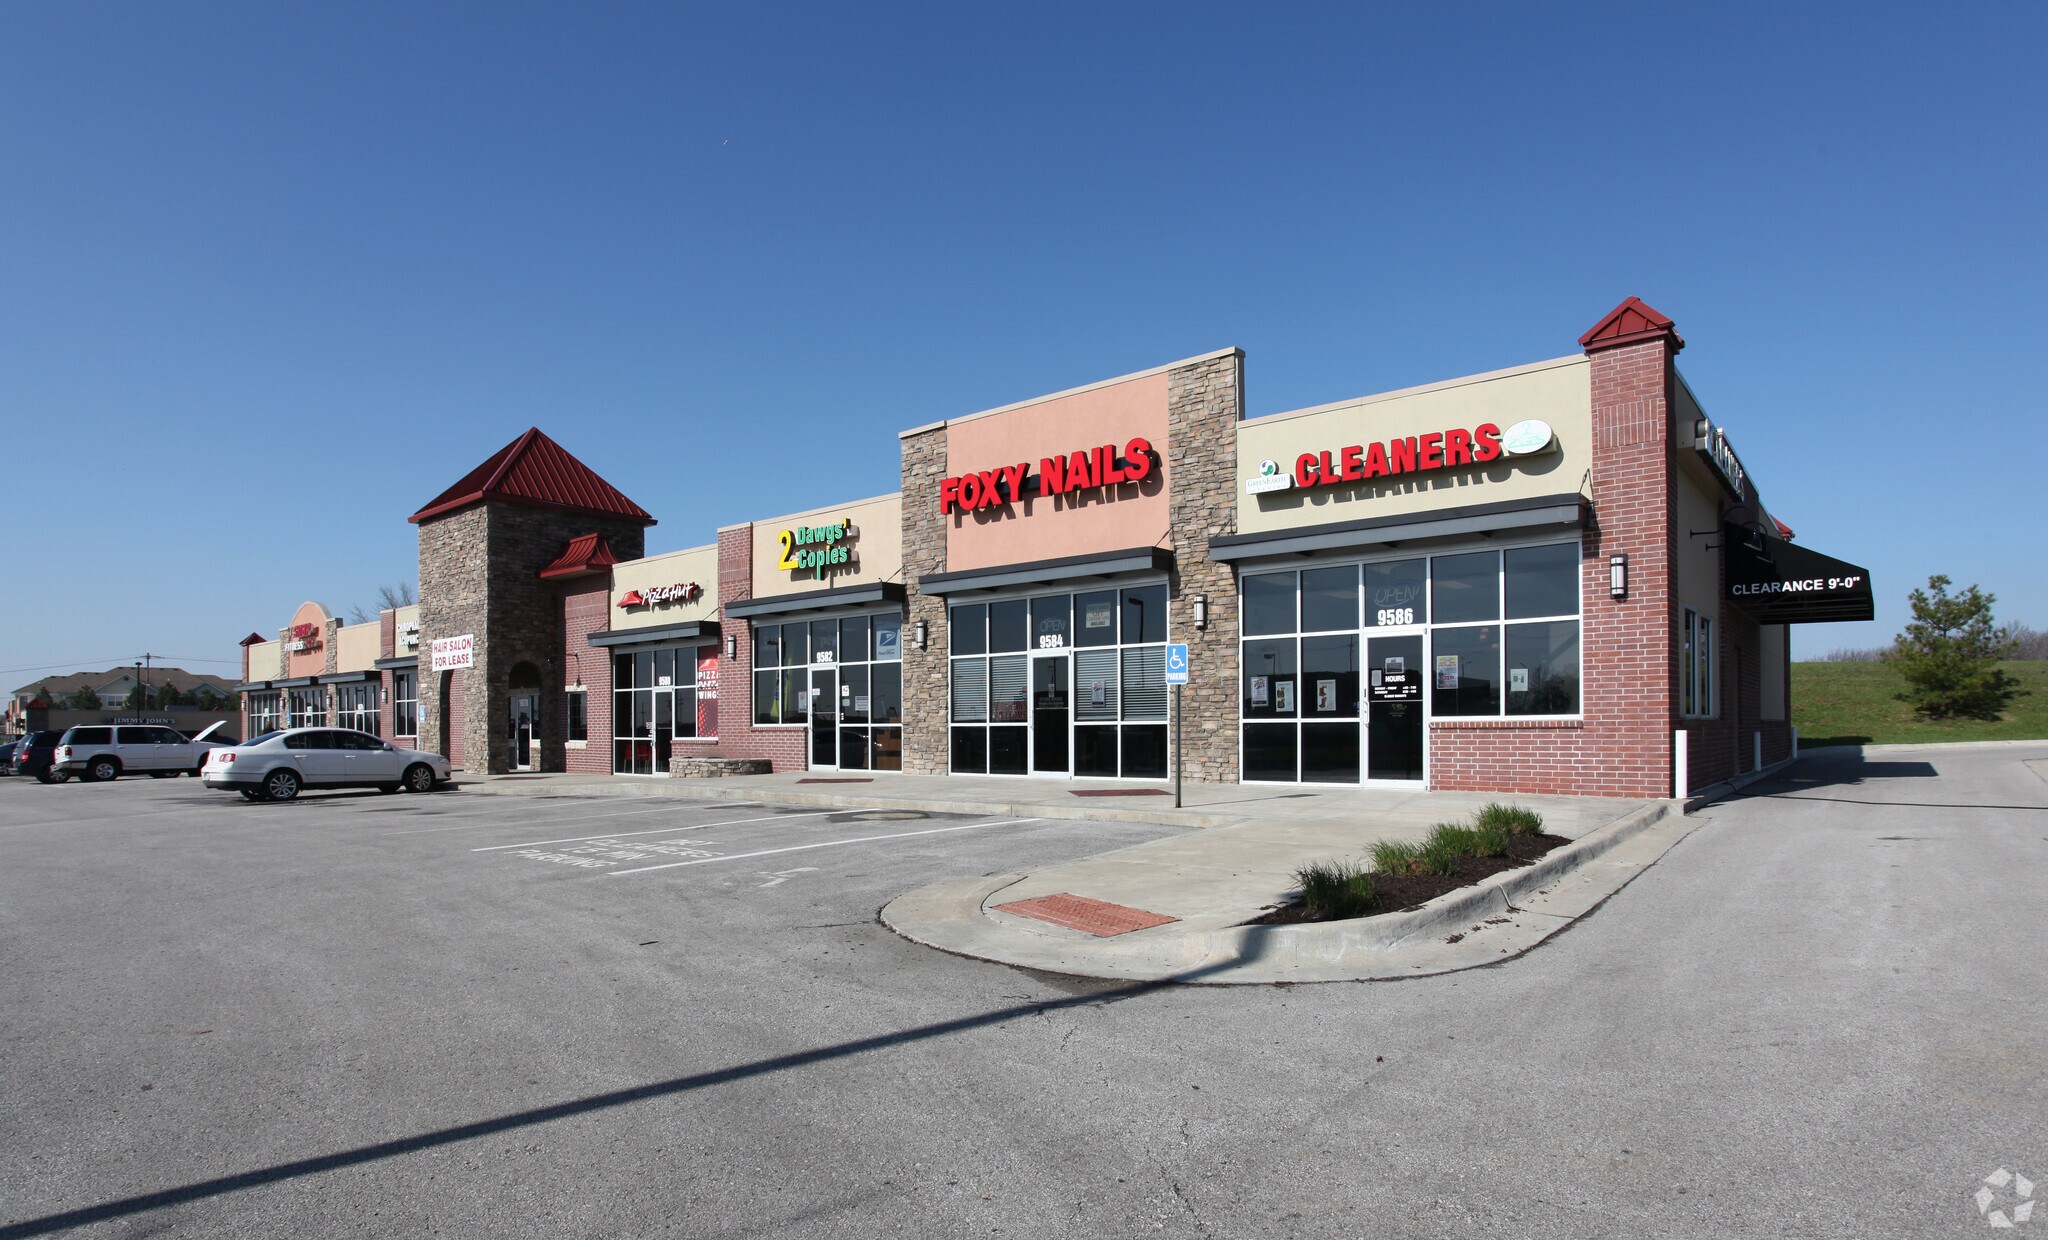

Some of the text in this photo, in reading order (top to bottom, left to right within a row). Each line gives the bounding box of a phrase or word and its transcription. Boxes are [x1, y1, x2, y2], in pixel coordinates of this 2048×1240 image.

[1296, 423, 1501, 488] CLEANERS
[941, 437, 1152, 515] FOXY NAILS
[778, 517, 848, 571] 2 Dawgs'
[798, 545, 848, 580] Copies
[641, 583, 693, 605] Pizza Hut
[1376, 586, 1416, 603] OPEN
[1732, 577, 1860, 595] CLEARANCE 9'-0"
[1377, 608, 1413, 626] 9586
[433, 638, 472, 653] HAIR SALON
[1040, 634, 1063, 648] 9584
[435, 654, 469, 667] FOR LEASE
[816, 651, 833, 662] 9582
[1167, 672, 1187, 680] PARKING
[504, 849, 618, 868] PARKING
